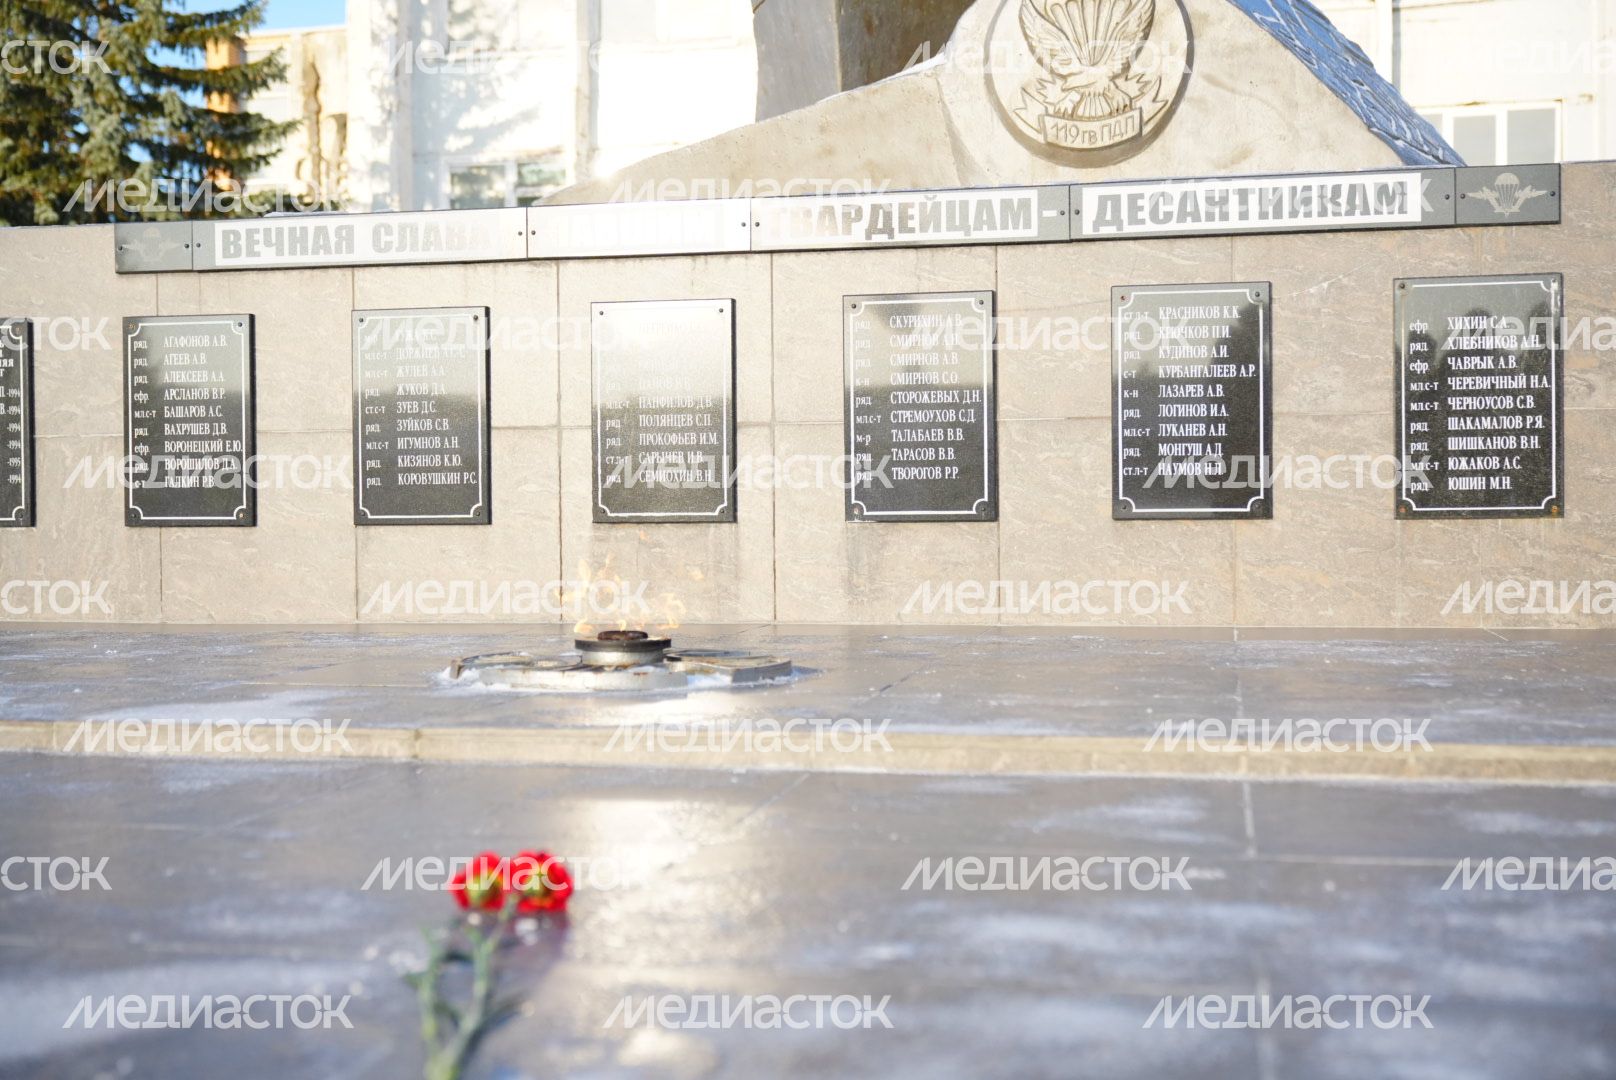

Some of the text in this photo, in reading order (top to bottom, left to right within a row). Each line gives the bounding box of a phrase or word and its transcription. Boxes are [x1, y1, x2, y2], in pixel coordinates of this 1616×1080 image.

[1051, 123, 1079, 143] 119
[1100, 119, 1135, 143] ПДП
[221, 223, 355, 259] ВЕЧНАЯ
[371, 220, 491, 254] СЛАВА
[1091, 181, 1409, 233] ДЕСАНТНИКАМ
[1159, 306, 1241, 319] КРАСНИКОВ К.К.
[890, 314, 943, 328] СКУРИХИН
[1448, 316, 1487, 330] ХИХИН
[1159, 325, 1231, 338] КРЮЧКОВ П.И.
[164, 335, 209, 347] АГАФОНОВ
[212, 335, 227, 346] А.В.
[890, 334, 938, 347] СМИРНОВ
[1448, 336, 1517, 350] ХЛЕБНИКОВ
[164, 353, 189, 365] АГЕЕВ
[1159, 345, 1207, 360] КУДИНОВ
[1211, 345, 1229, 358] А.И.
[890, 353, 939, 366] СМИРНОВ
[1410, 355, 1518, 374] ефр. ЧАВРЫК А.В.
[164, 371, 208, 382] АЛЕКСЕЕВ
[1124, 364, 1256, 378] с-т КУРБАНГАЛЕЕВ А.Р.
[891, 372, 939, 385] СМИРНОВ
[1448, 374, 1526, 390] ЧЕРЕВИЧНЫЙ
[1530, 375, 1551, 388] Н.А.
[164, 388, 209, 400] АРСЛАНОВ
[212, 388, 226, 399] В.Р.
[397, 383, 428, 395] ЖУКОВ
[1124, 384, 1224, 398] к-н ЛАЗАРЕВ А.В.
[639, 396, 693, 408] ПАНФИЛОВ
[891, 391, 959, 404] СТОРОЖЕВЫХ
[963, 390, 981, 404] Д.Н.
[1448, 396, 1513, 410] ЧЕРНОУСОВ
[1517, 395, 1535, 409] С.В.
[164, 406, 206, 417] БАШАРОВ
[208, 405, 223, 417] А.С.
[397, 401, 418, 413] ЗУЕВ
[1124, 404, 1229, 420] ряд. ЛОГИНОВ И.А.
[639, 414, 693, 427] ПОЛЯНЦЕВ
[891, 409, 956, 423] СТРЕМОУХОВ
[959, 409, 976, 423] С.Д.
[165, 423, 210, 435] ВАХРУШЕВ
[212, 423, 228, 436] Д.В.
[397, 418, 432, 431] ЗУЙКОВ
[1448, 416, 1523, 430] ШАКАМАЛОВ
[1527, 416, 1545, 429] Р.Я.
[857, 428, 964, 445] м-р ТАЛАБАЕВ В.В.
[1158, 424, 1206, 436] ЛУКАНЕВ
[1209, 424, 1228, 436] А.Н.
[397, 437, 441, 449] ИГУМНОВ
[444, 437, 460, 448] А.Н.
[639, 433, 696, 445] ПРОКОФЬЕВ
[700, 433, 718, 445] И.М.
[1448, 436, 1516, 450] ШИШКАНОВ
[1521, 436, 1541, 449] В.Н.
[165, 439, 222, 454] ВОРОНЕЦКИЙ
[226, 440, 243, 452] Е.Ю.
[1158, 443, 1202, 456] МОНГУШ
[1206, 443, 1223, 457] А.Д.
[639, 452, 684, 464] САРЫЧЕВ
[892, 448, 935, 460] ТАРАСОВ
[939, 447, 956, 460] В.В.
[165, 458, 219, 470] ВОРОШИЛОВ
[398, 455, 441, 467] КИЗЯНОВ
[444, 455, 462, 466] К.Ю.
[1448, 457, 1499, 470] ЮЖАКОВ
[1503, 456, 1522, 469] А.С.
[892, 467, 941, 479] ТВОРОГОВ
[945, 466, 959, 479] Р.Р.
[1158, 463, 1201, 475] НАУМОВ
[165, 476, 199, 488] ГАЛКИН
[398, 473, 460, 485] КОРОВУШКИН
[464, 472, 477, 484] Р.С.
[1448, 477, 1486, 490] ЮШИН
[1490, 476, 1512, 489] М.Н.
